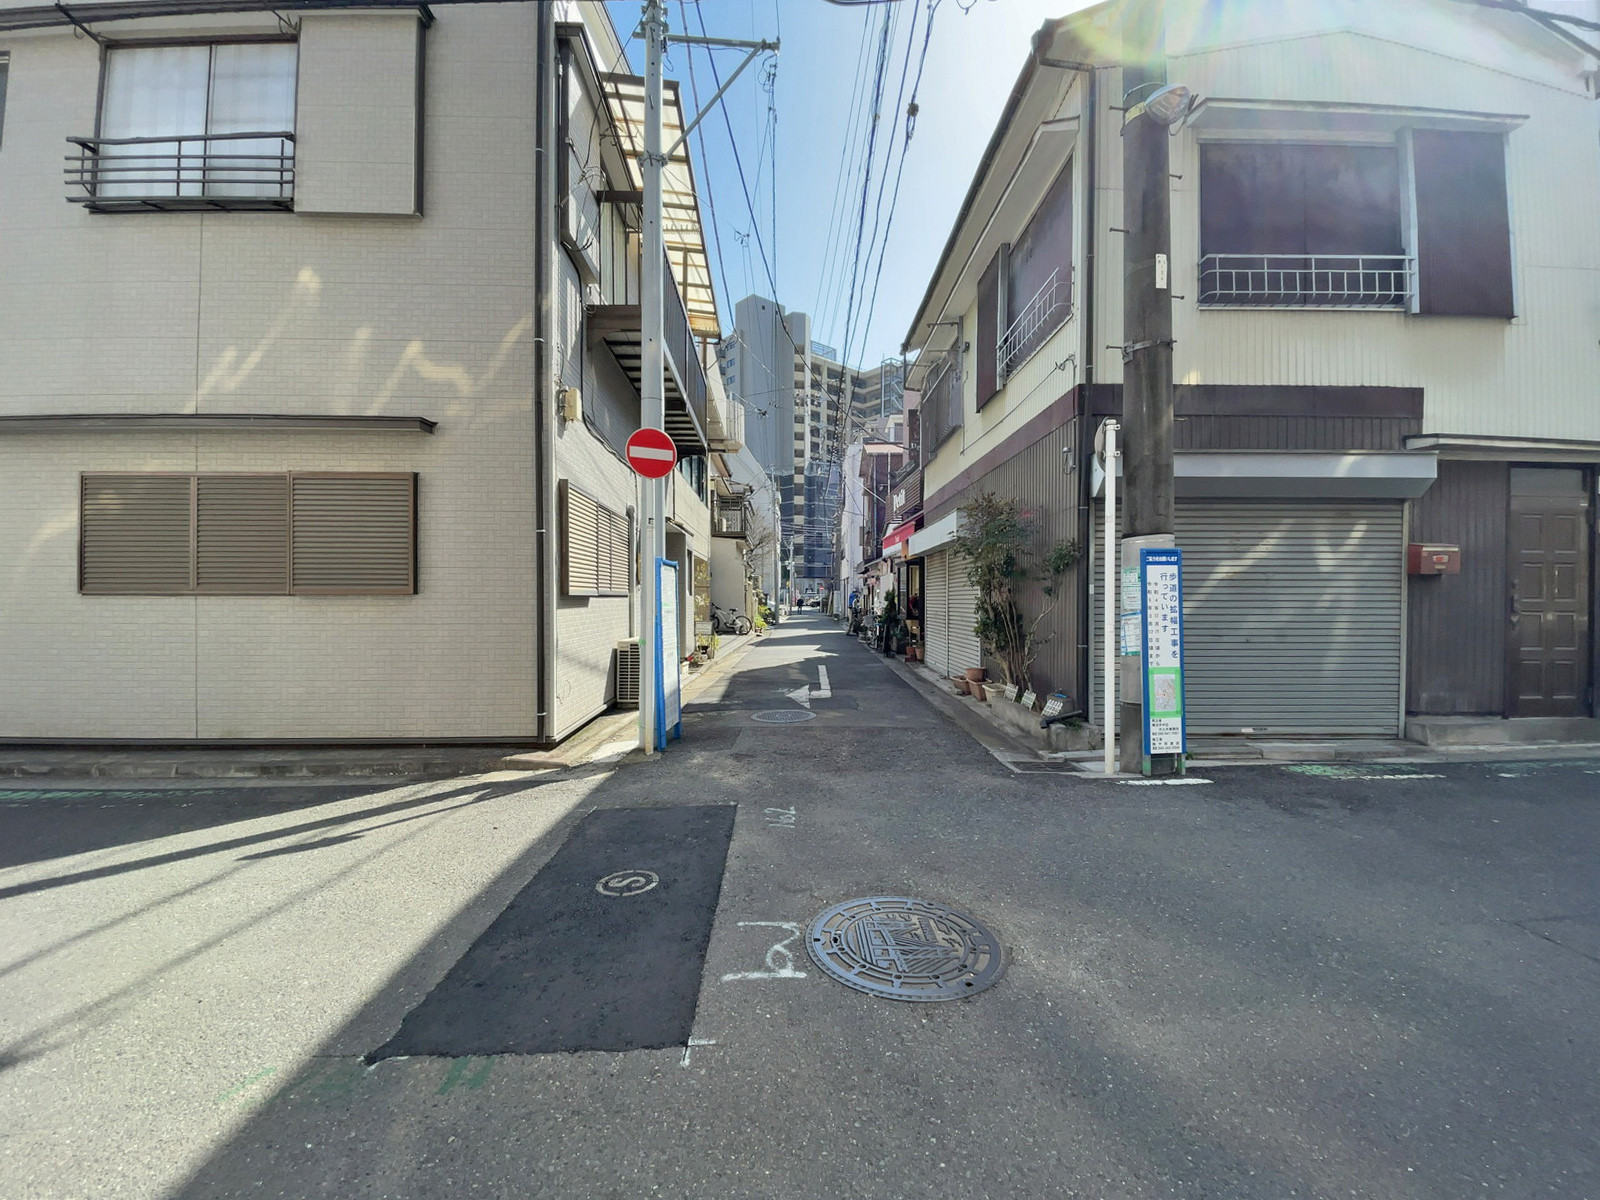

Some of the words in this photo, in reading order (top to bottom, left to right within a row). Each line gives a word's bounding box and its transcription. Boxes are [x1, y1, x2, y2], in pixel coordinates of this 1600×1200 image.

[1160, 572, 1169, 633] 行っています
[1169, 572, 1179, 659] 歩道の拡幅工事を
